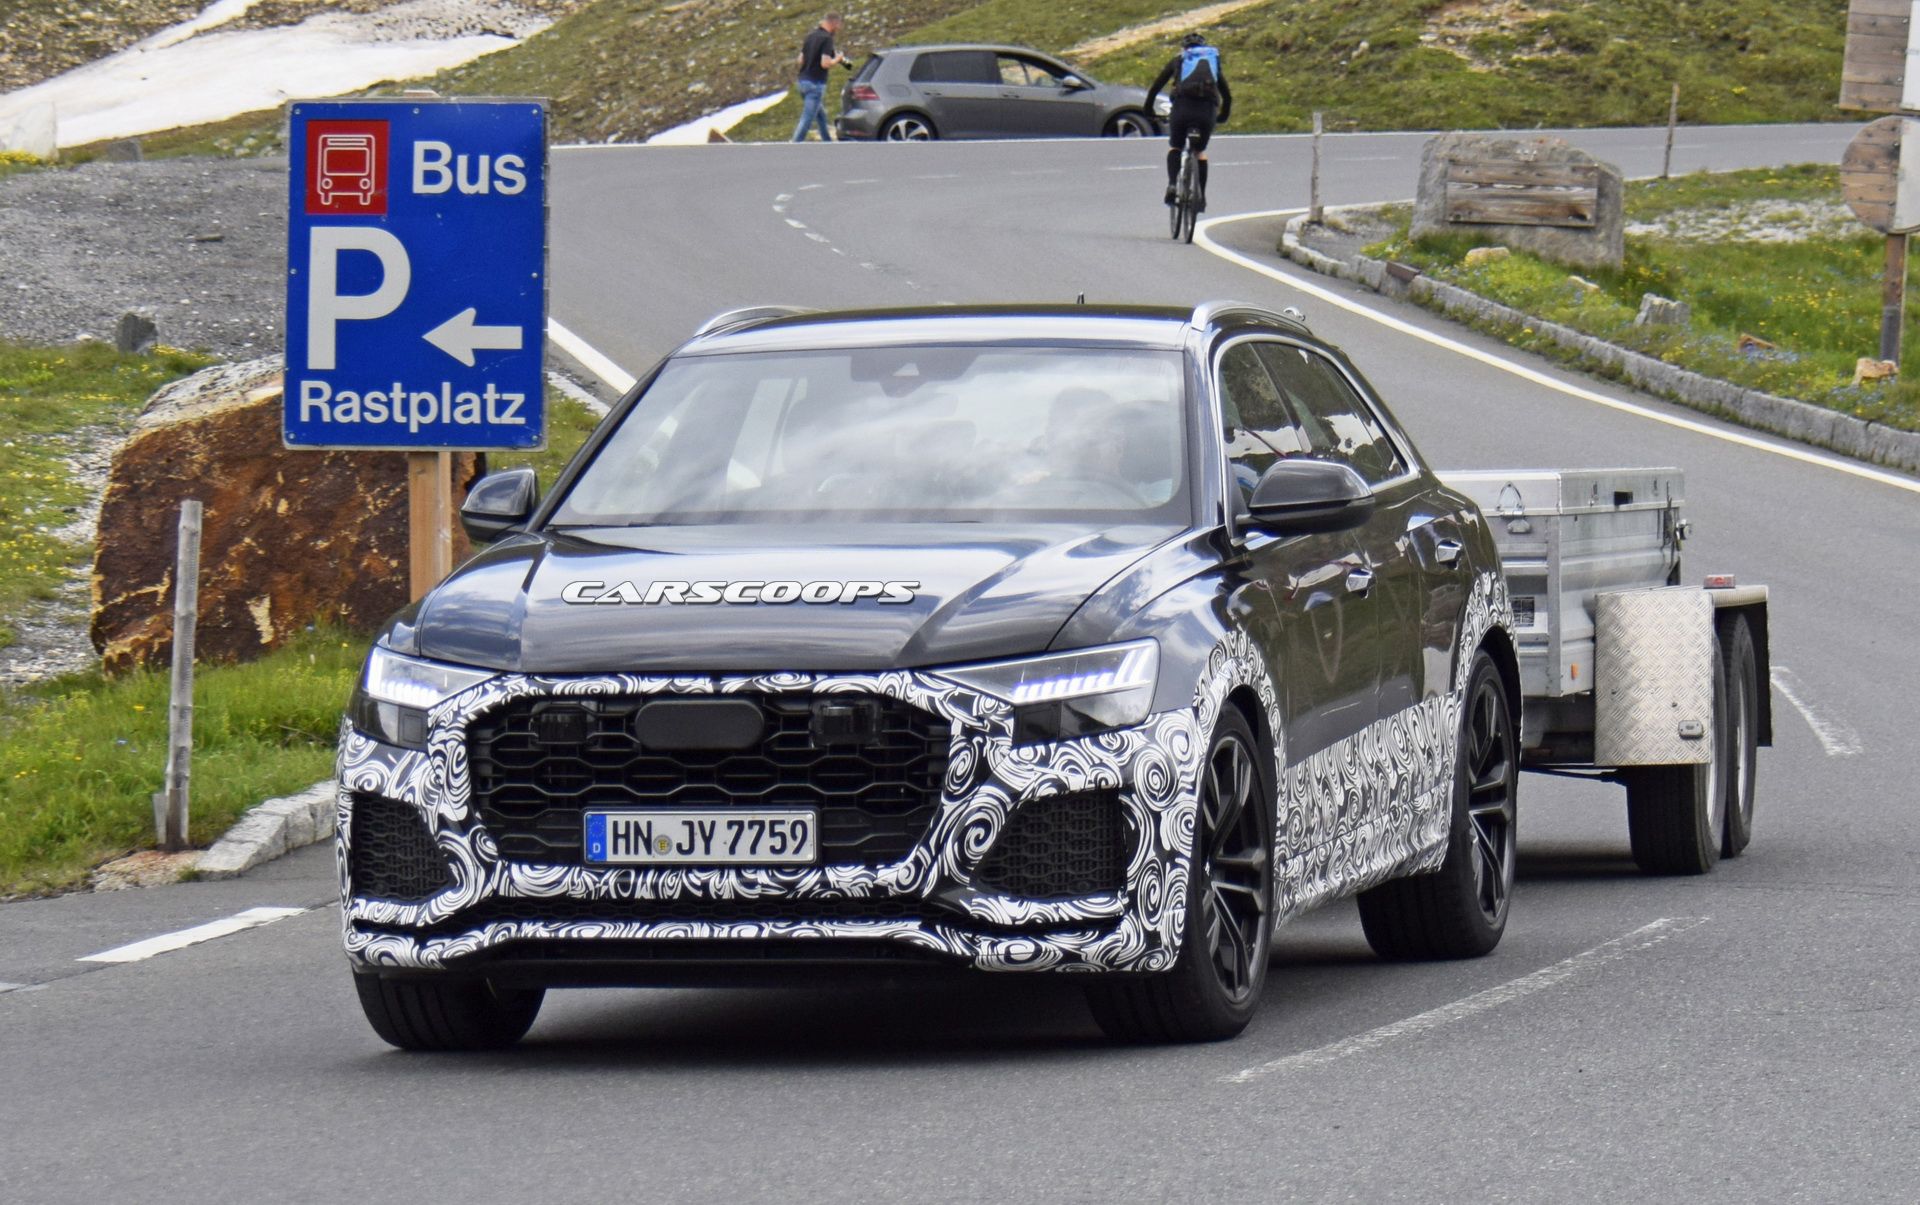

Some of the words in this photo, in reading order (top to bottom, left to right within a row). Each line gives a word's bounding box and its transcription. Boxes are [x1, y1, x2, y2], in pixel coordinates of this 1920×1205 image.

[412, 140, 527, 195] Bus
[307, 226, 411, 370] P
[300, 380, 526, 433] Rastplatz
[592, 843, 601, 854] D
[612, 820, 652, 855] HN
[676, 820, 716, 855] JY
[727, 819, 808, 855] 7759
